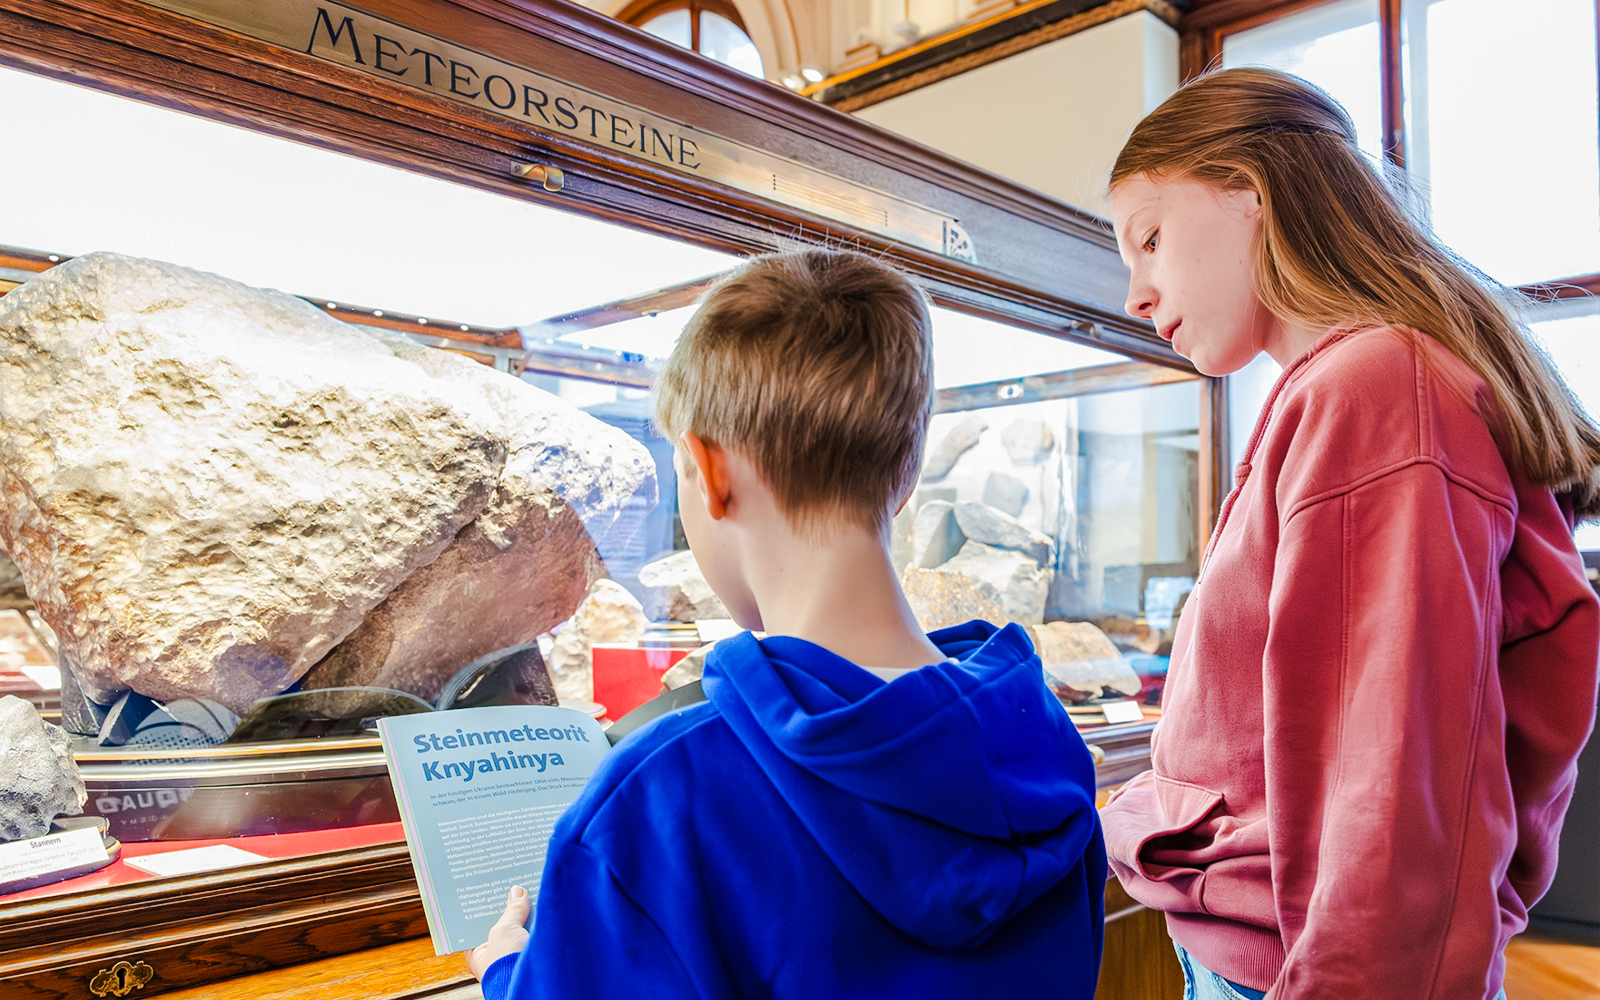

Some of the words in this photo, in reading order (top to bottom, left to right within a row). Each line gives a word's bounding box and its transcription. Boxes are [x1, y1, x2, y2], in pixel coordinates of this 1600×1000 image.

[305, 7, 701, 170] METEORSTEINE
[413, 724, 590, 753] Steinmeteorit
[422, 750, 565, 782] Knyahinya
[448, 789, 473, 797] heutigen
[496, 781, 532, 789] beobachteten
[29, 837, 62, 849] Stannern
[485, 844, 504, 852] werden
[465, 883, 490, 891] Meteorite
